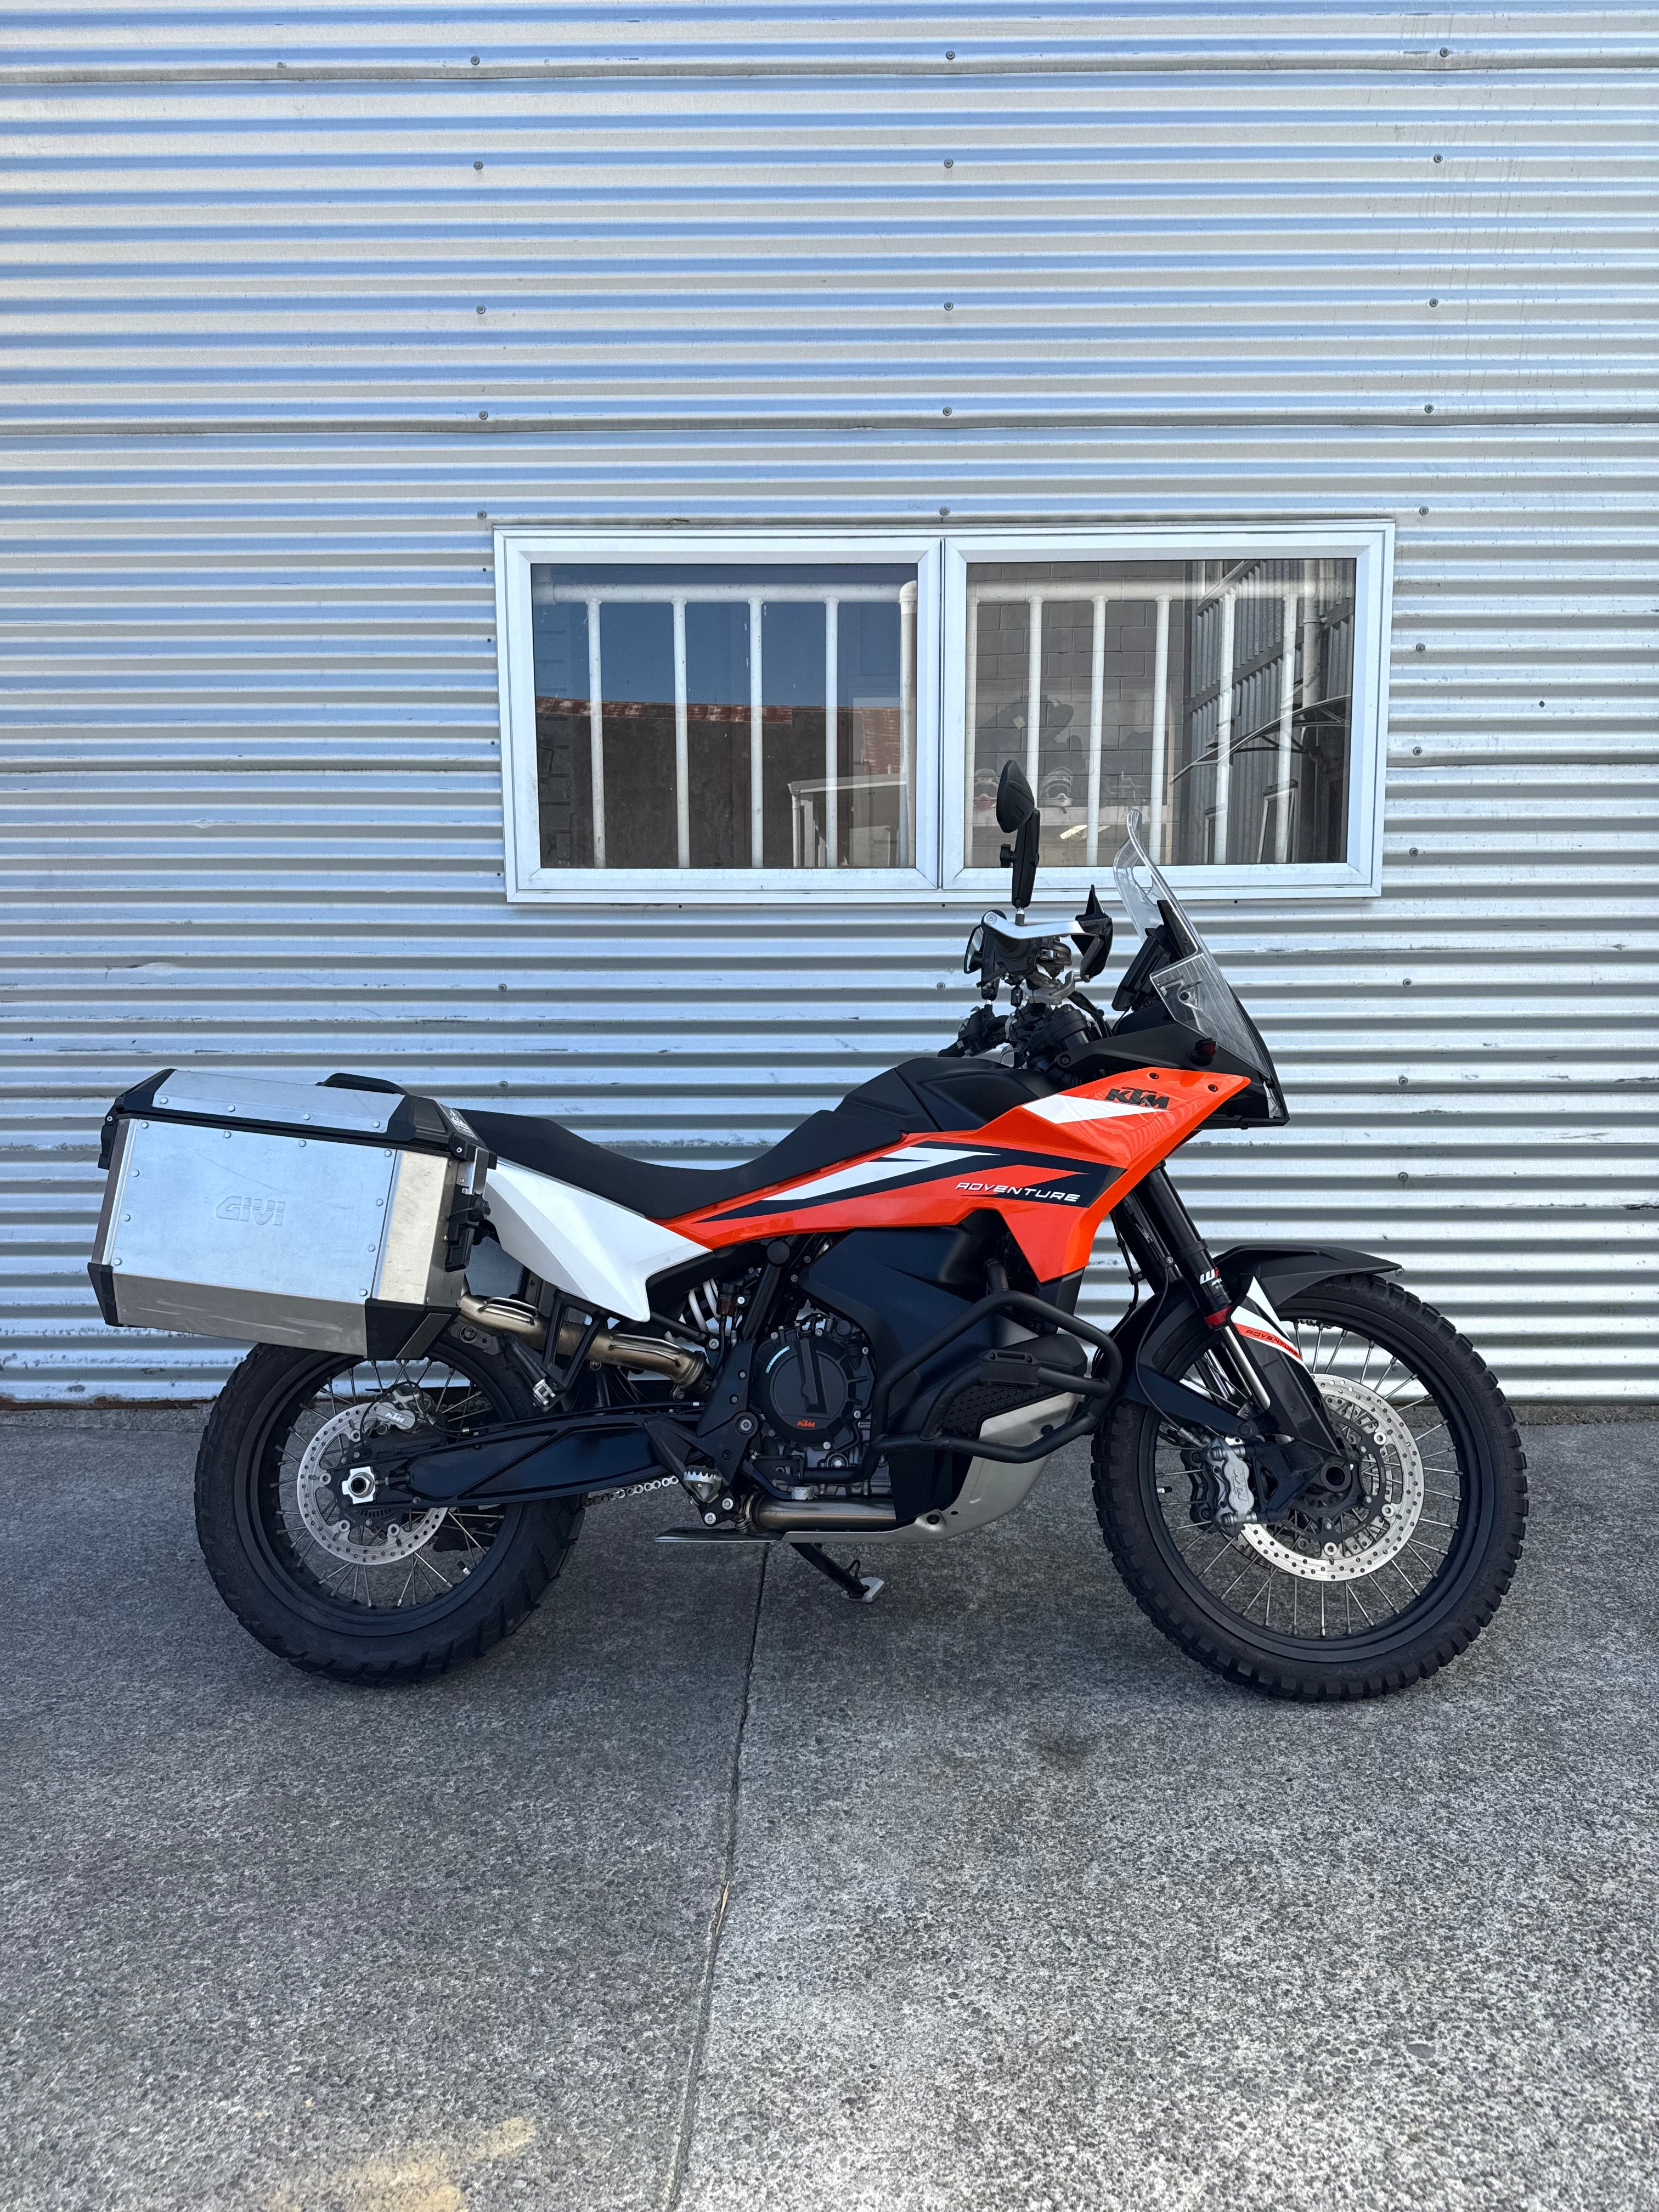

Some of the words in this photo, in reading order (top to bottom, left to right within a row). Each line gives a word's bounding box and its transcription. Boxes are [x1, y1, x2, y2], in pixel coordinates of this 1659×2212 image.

[1104, 1086, 1170, 1109] KTM
[956, 1182, 1081, 1202] ADVENTURE
[216, 1196, 285, 1226] GIVI
[1245, 1330, 1299, 1356] ADVENTURE
[385, 1411, 405, 1423] KTM
